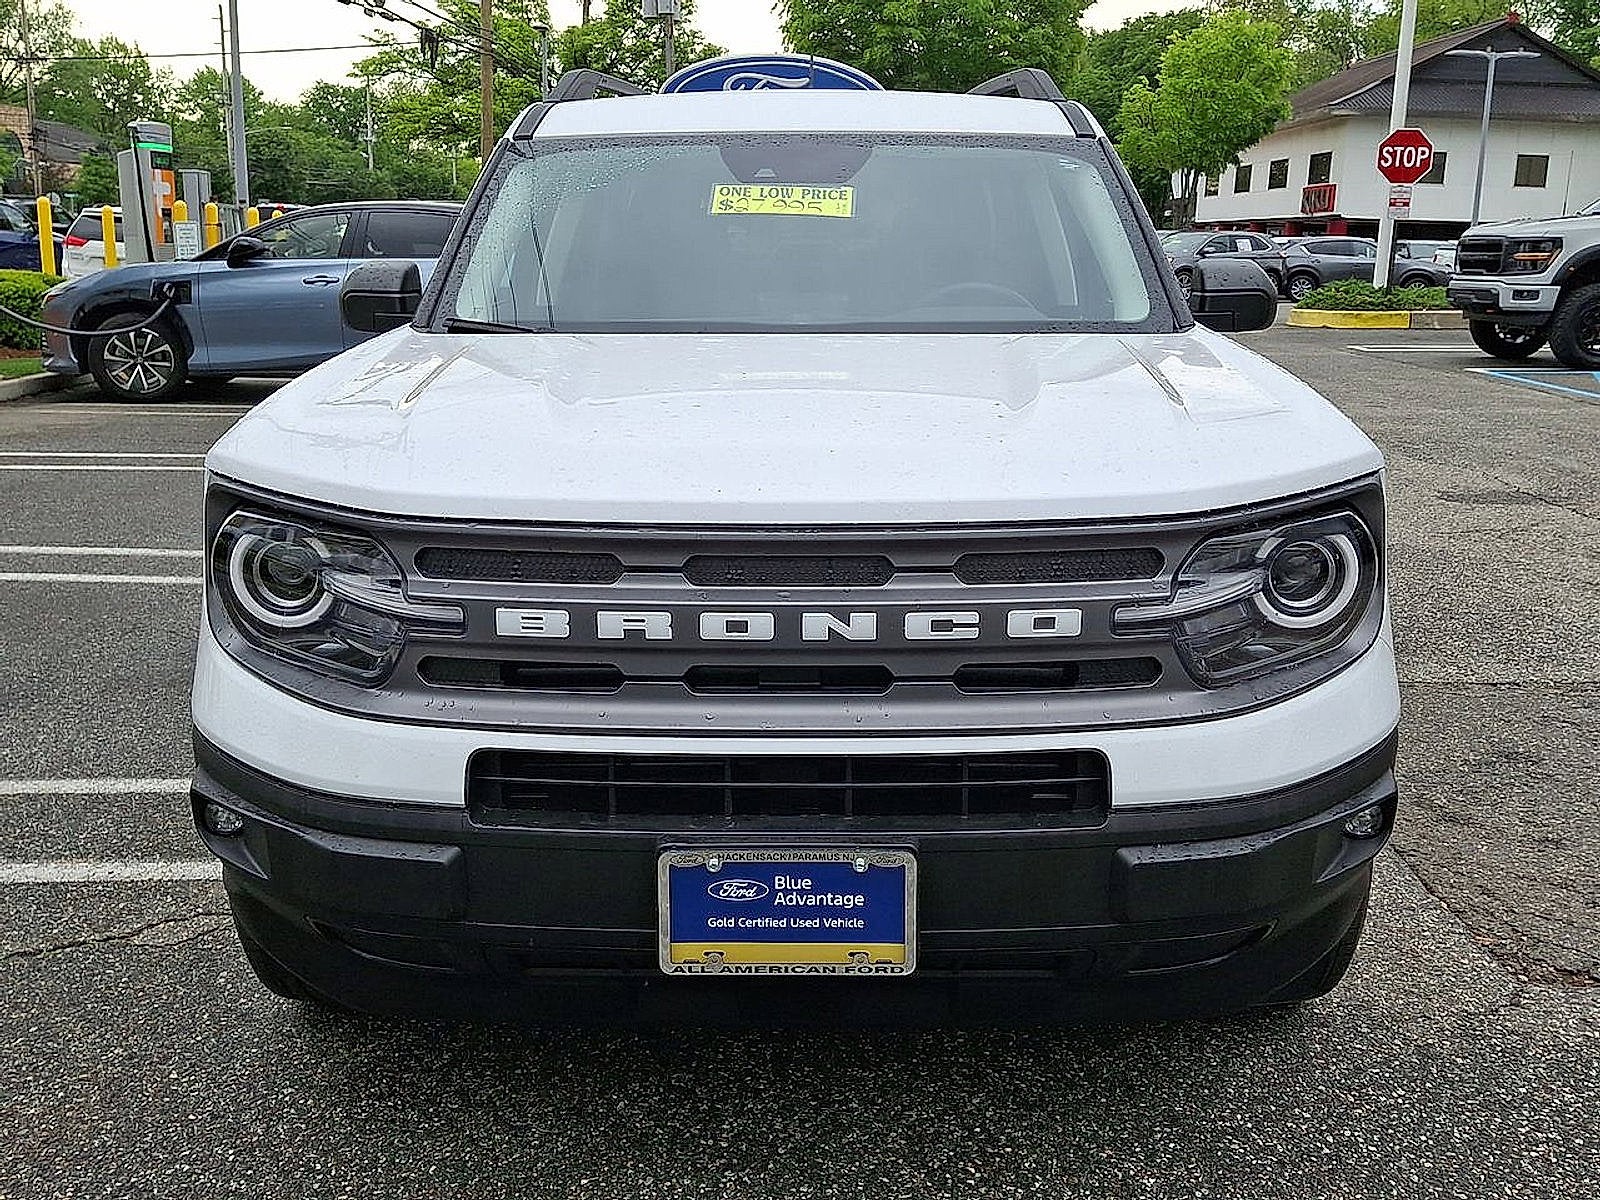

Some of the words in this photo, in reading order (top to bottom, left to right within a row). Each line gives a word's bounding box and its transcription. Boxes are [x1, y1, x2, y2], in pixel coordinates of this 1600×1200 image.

[1380, 146, 1430, 168] STOP
[719, 186, 752, 198] ONE
[759, 187, 794, 199] LOW
[801, 188, 848, 201] PRICE
[495, 606, 1083, 641] BRONCO
[719, 882, 757, 898] Ford
[774, 875, 812, 890] Blue
[774, 891, 865, 909] Advantage
[707, 917, 735, 928] Gold
[738, 917, 787, 928] Certified
[790, 917, 820, 928] Used
[823, 917, 865, 928] Vehicle
[671, 965, 711, 974] ALL
[716, 965, 837, 974] AMERICAN
[844, 965, 905, 974] FORD
